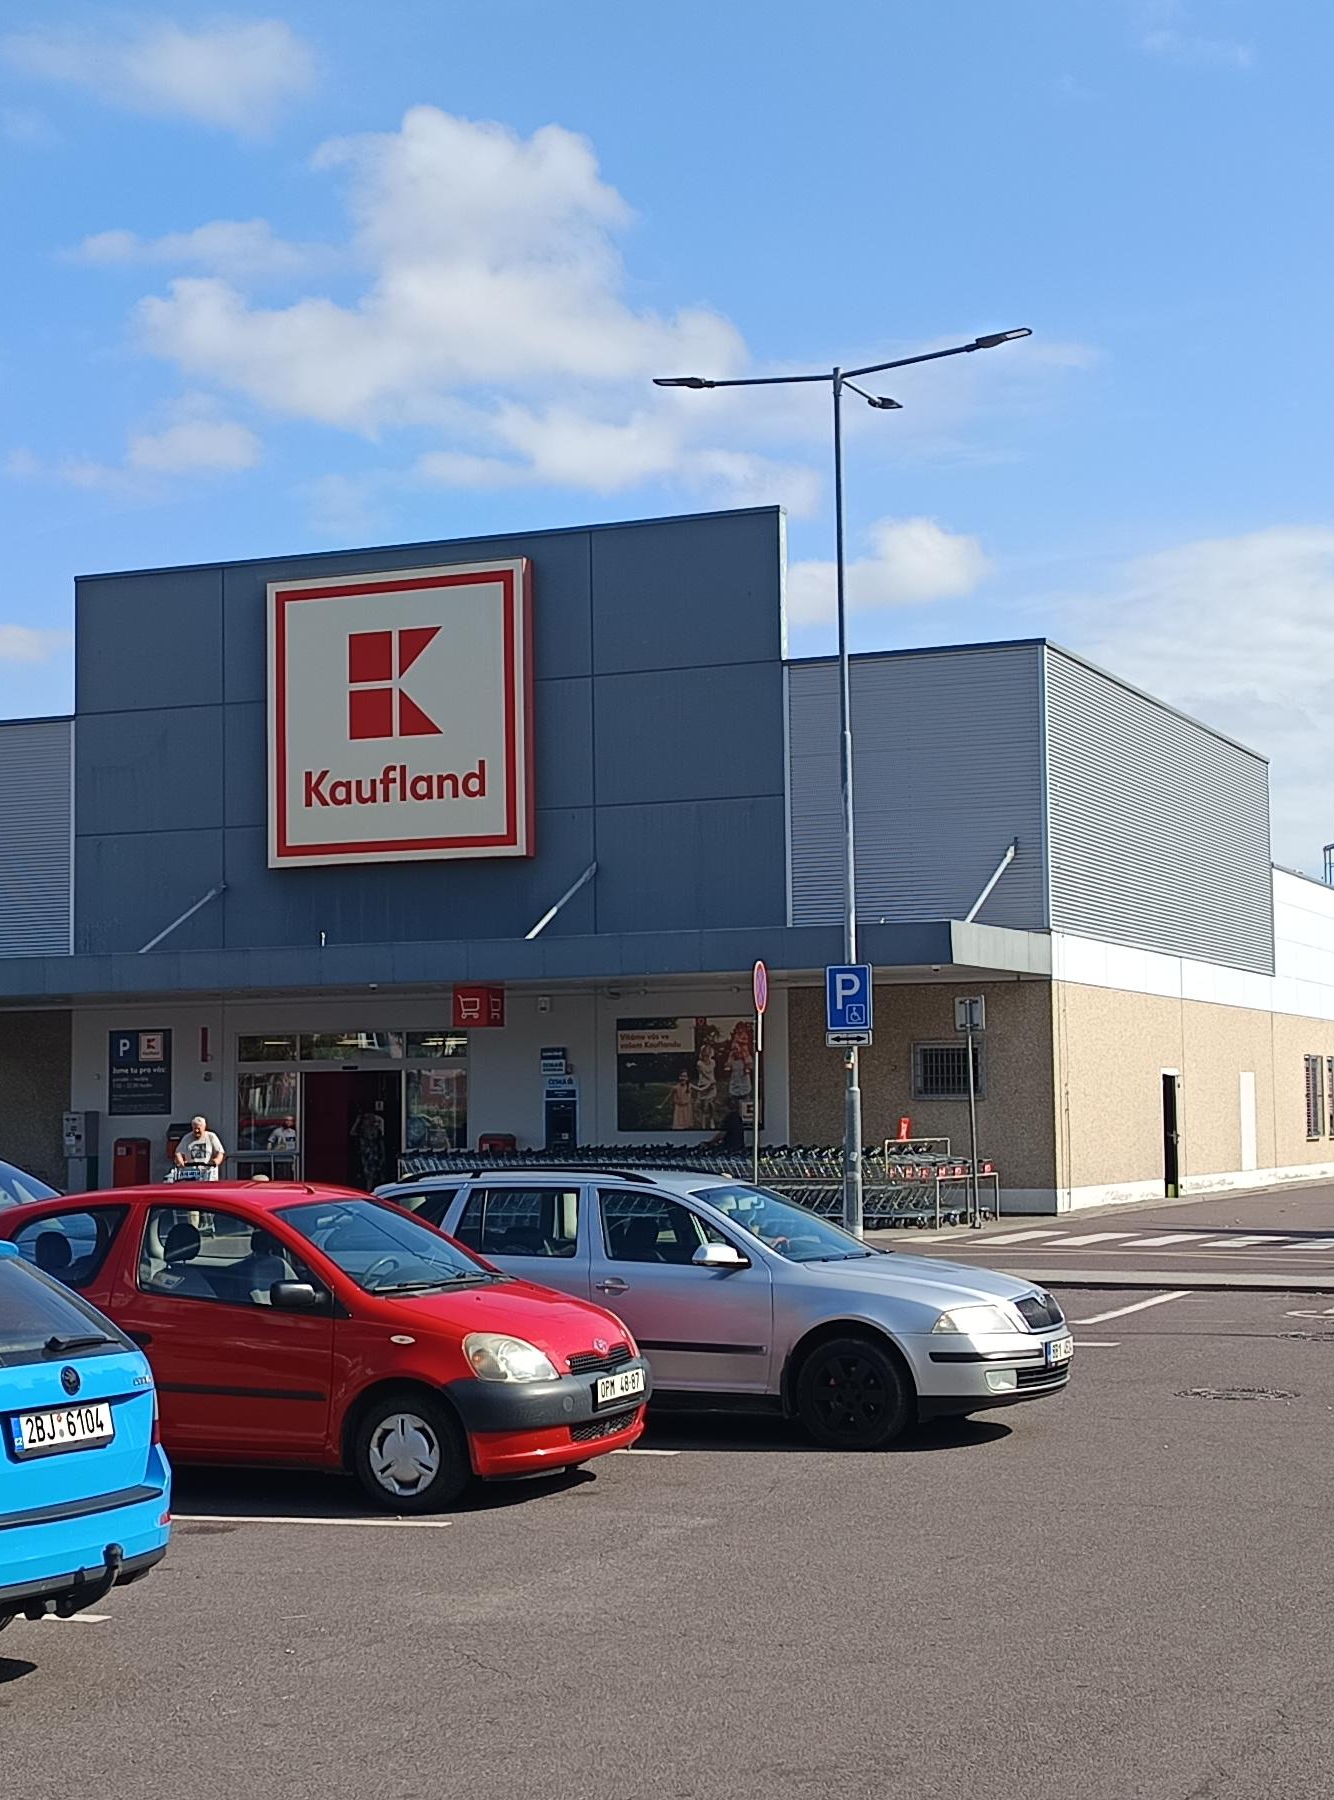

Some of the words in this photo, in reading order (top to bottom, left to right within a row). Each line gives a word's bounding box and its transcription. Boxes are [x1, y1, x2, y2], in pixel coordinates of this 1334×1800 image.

[304, 759, 486, 807] Kaufland
[836, 973, 860, 1010] P
[119, 1038, 131, 1057] P
[619, 1032, 646, 1041] Vítáme
[647, 1032, 660, 1040] vás
[619, 1041, 643, 1050] vašem
[643, 1041, 681, 1049] Kauflandu
[25, 1410, 57, 1444] 2BJ
[66, 1407, 104, 1438] 6104
